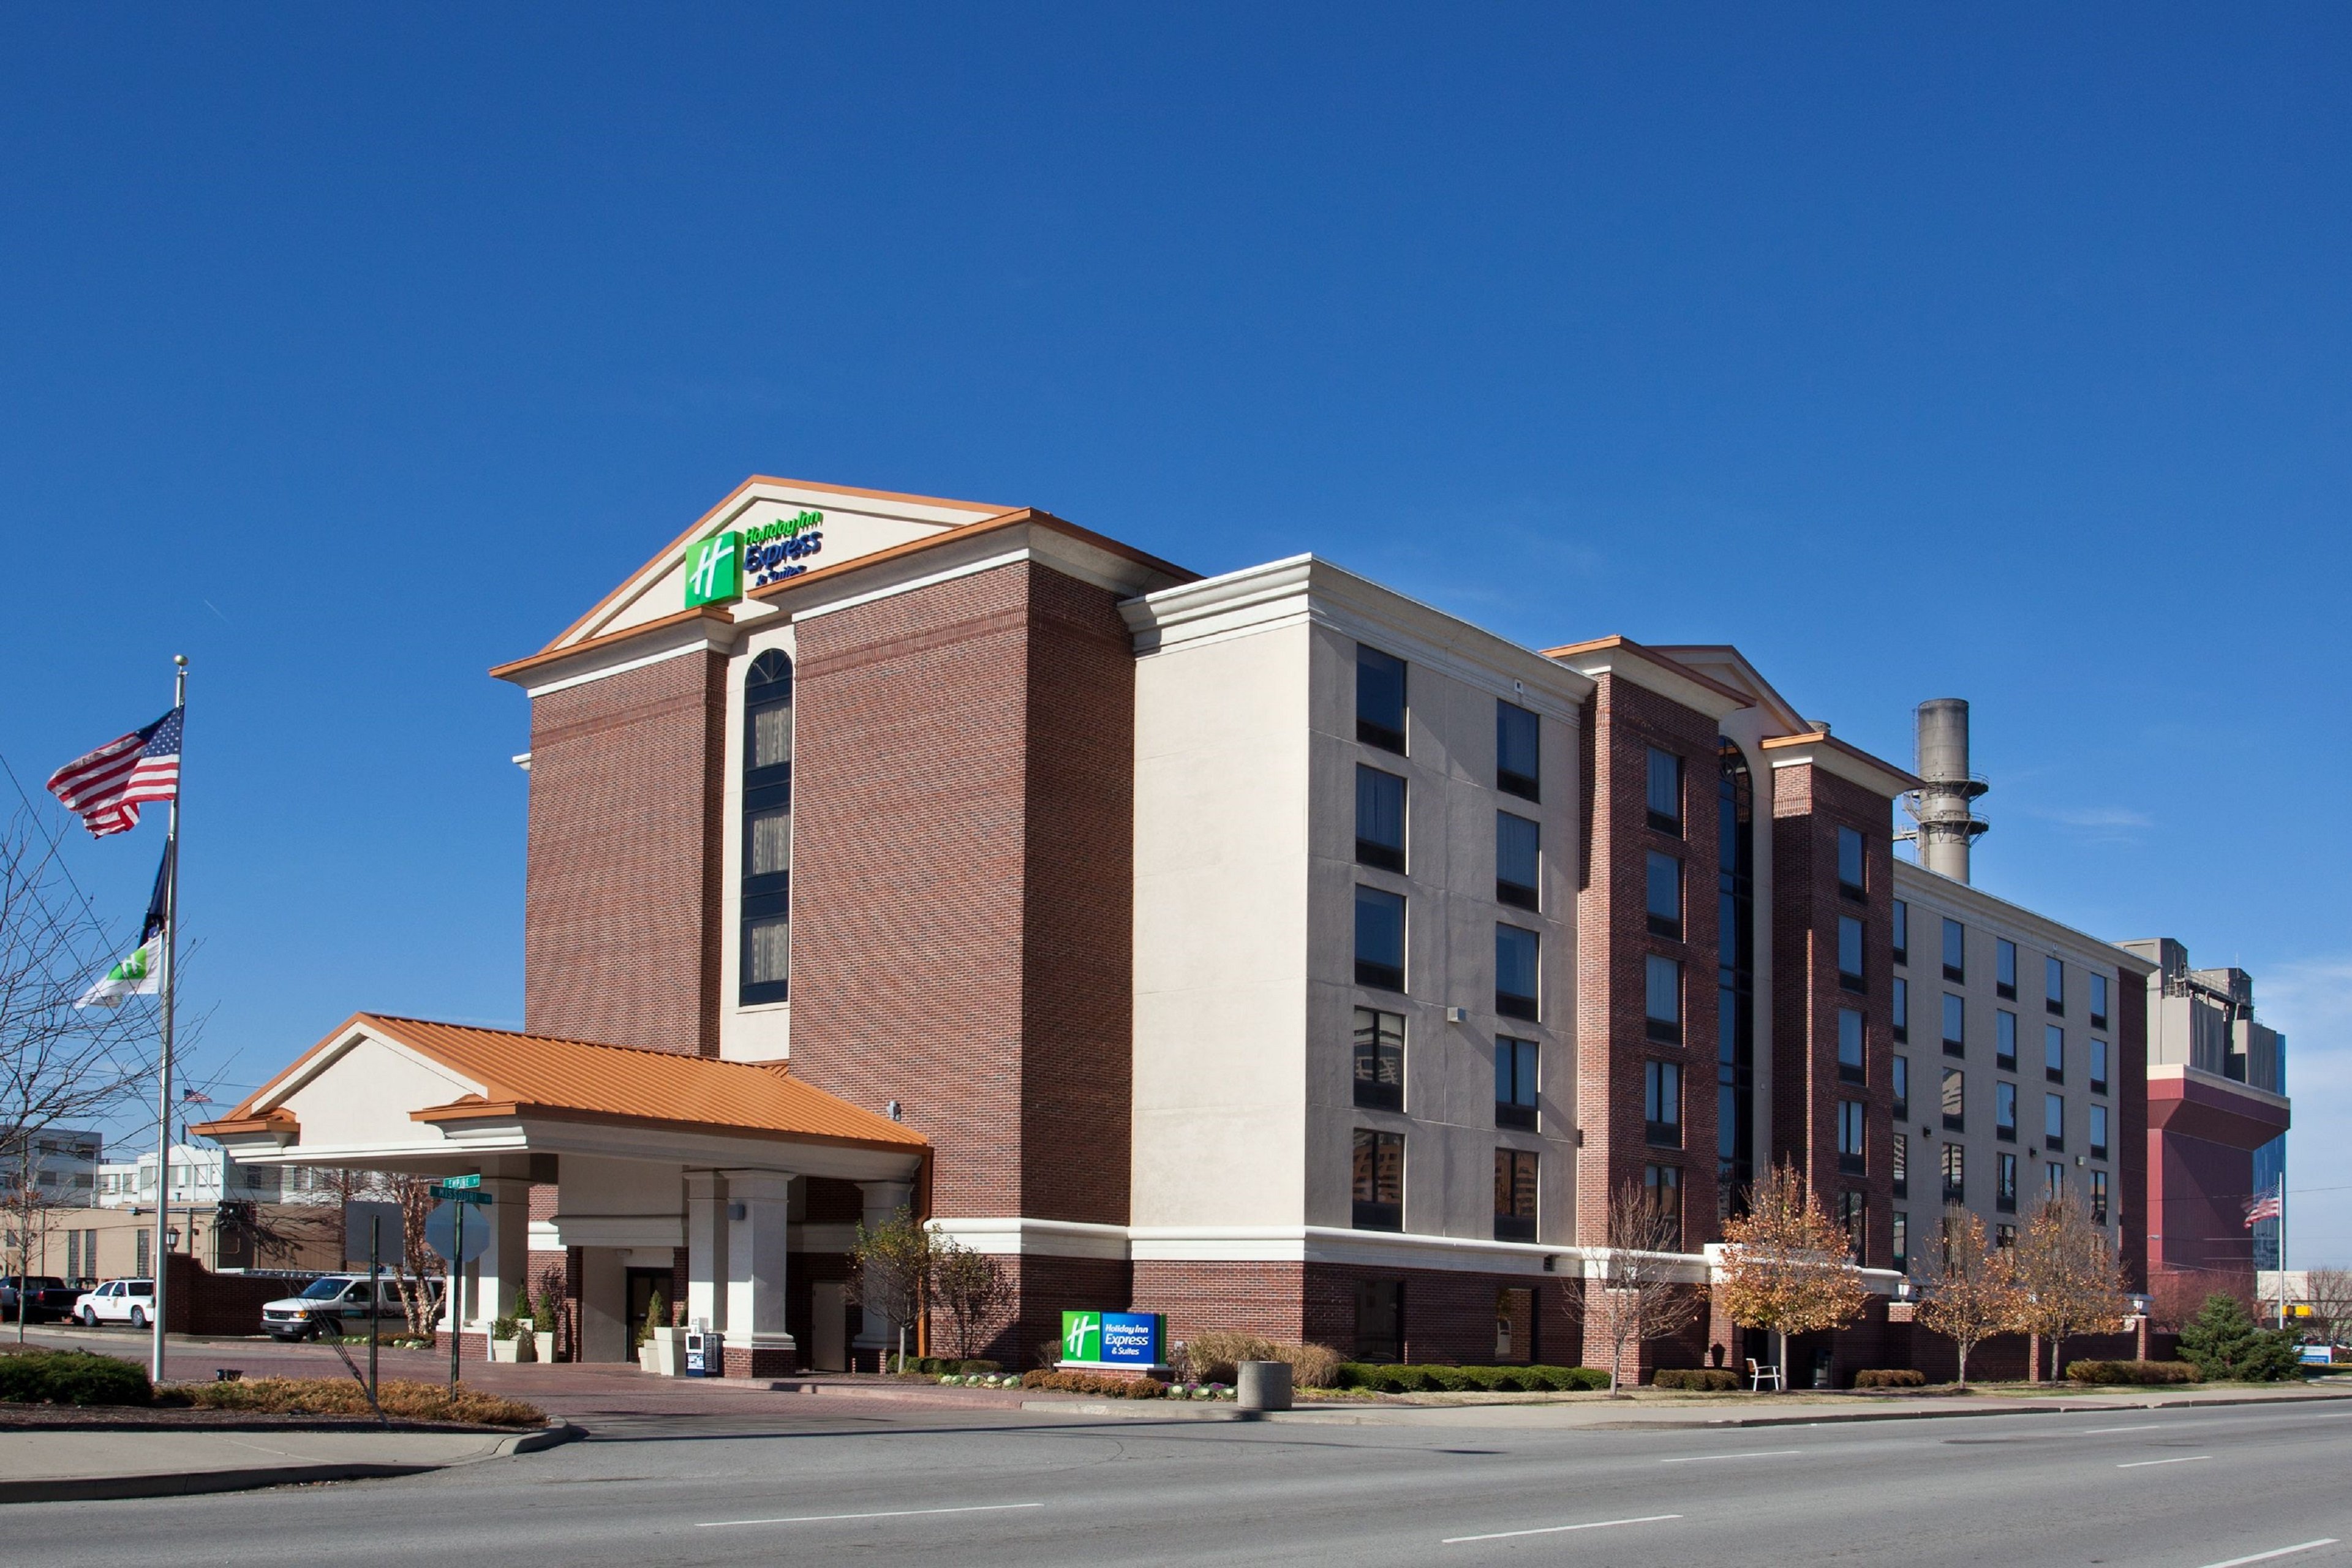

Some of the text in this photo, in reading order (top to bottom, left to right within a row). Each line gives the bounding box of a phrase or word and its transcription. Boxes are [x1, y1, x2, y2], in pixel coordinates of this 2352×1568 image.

[744, 510, 823, 545] Holiday Inn
[744, 531, 823, 572] Express
[448, 1177, 469, 1188] EMPIRE
[439, 1189, 477, 1201] MISSOURI
[1105, 1324, 1148, 1335] Holiday Inn
[1105, 1333, 1149, 1347] Express
